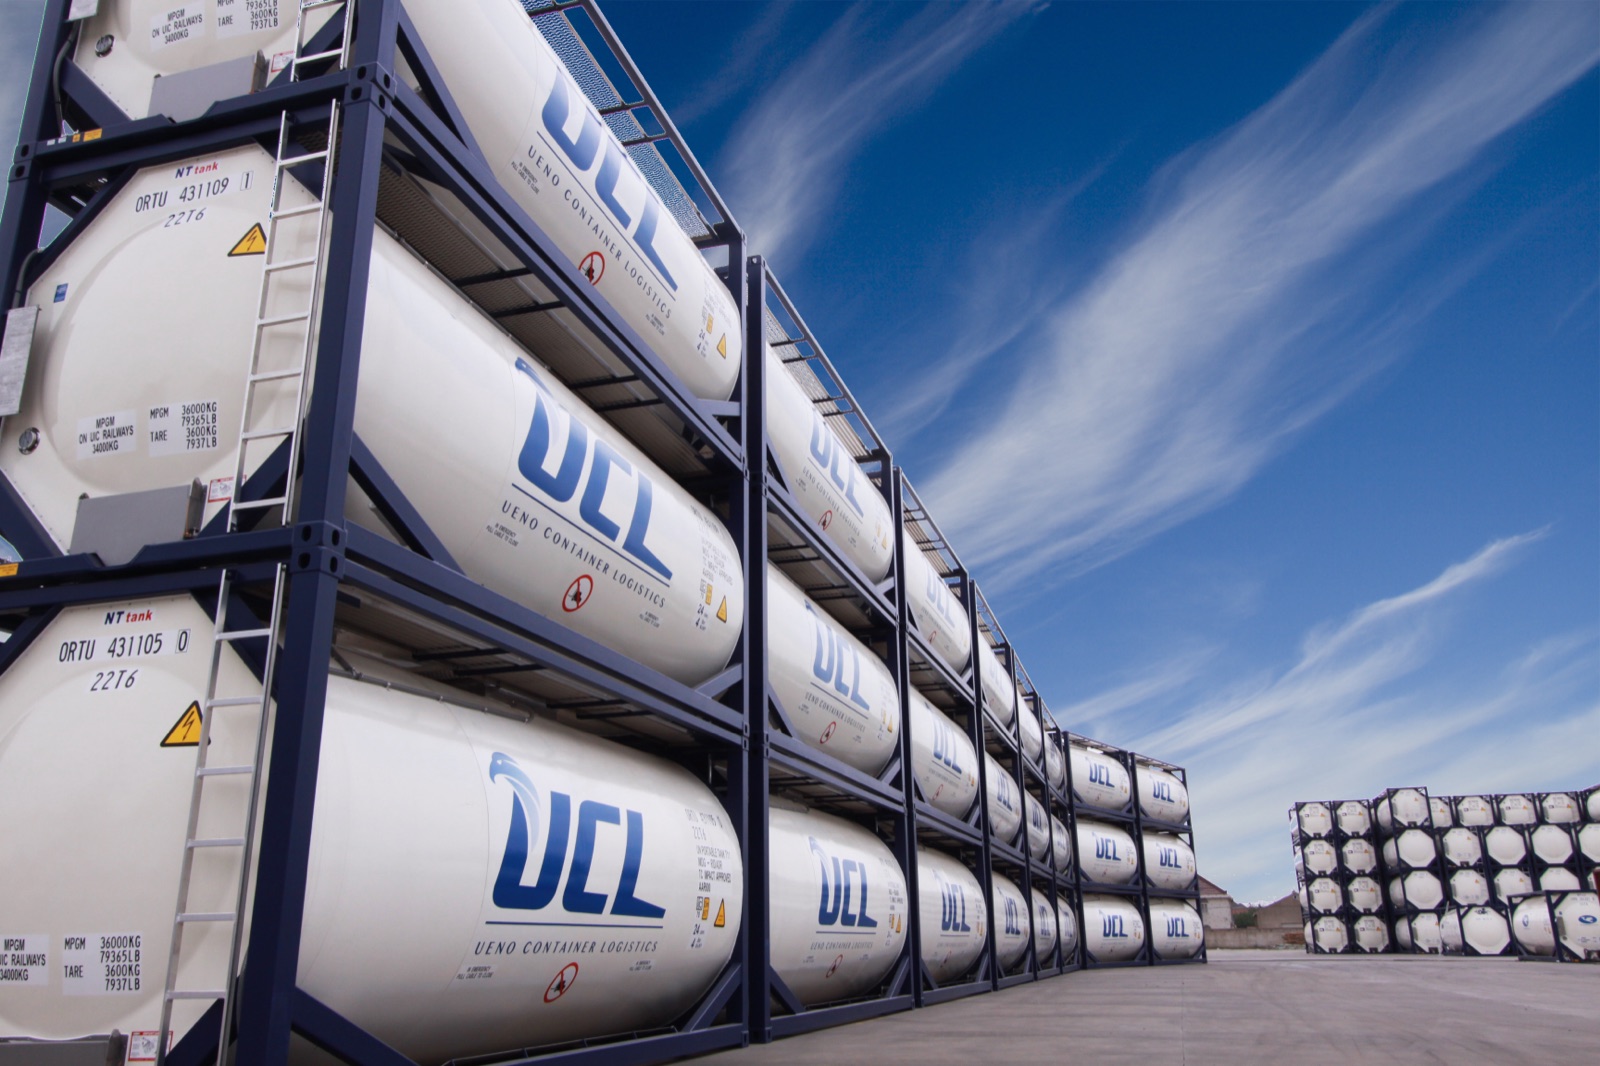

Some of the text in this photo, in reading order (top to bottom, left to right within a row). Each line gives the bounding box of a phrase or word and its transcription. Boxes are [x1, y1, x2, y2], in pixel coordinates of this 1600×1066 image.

[167, 8, 185, 22] MPGM
[218, 14, 234, 27] TARE
[250, 8, 278, 20] 3600KG
[152, 14, 202, 38] ON UIC RAILWAYS
[250, 18, 278, 30] 7937LB
[165, 29, 188, 44] 34000KG
[194, 162, 218, 174] tank
[135, 191, 168, 212] ORTU
[179, 177, 230, 202] 431109
[164, 208, 206, 228] 22T6
[528, 144, 560, 186] UENO
[564, 189, 621, 261] CONTAINER
[624, 262, 672, 319] LOGISTICS
[150, 407, 169, 419] MPGM
[182, 402, 217, 416] 36000KG
[96, 416, 115, 429] MPGM
[181, 414, 217, 427] 79365LB
[79, 426, 134, 444] ON UIC RAILWAYS
[150, 430, 168, 442] TARE
[186, 425, 217, 438] 3600KG
[92, 441, 118, 454] 34000KG
[186, 437, 217, 450] 7937LB
[518, 389, 673, 580] UCL
[502, 500, 538, 530] UENO
[544, 527, 610, 575] CONTAINER
[613, 569, 666, 608] LOGISTICS
[126, 610, 152, 622] tank
[59, 630, 189, 662] ORTU 431105 0
[813, 619, 870, 711] UCL
[90, 669, 138, 692] 22T6
[1089, 763, 1115, 788] UCL
[1153, 779, 1175, 803] UCL
[492, 790, 666, 919] UCL
[1095, 837, 1121, 862] UCL
[1159, 847, 1182, 869] UCL
[818, 856, 878, 928] UCL
[941, 882, 970, 932] UCL
[1103, 915, 1128, 938] UCL
[1167, 917, 1189, 938] UCL
[4, 939, 25, 951] MPGM
[64, 937, 86, 950] MPGM
[100, 936, 141, 949] 36000KG
[474, 941, 658, 955] UENO CONTAINER LOGISTICS
[11, 954, 46, 966] RAILWAYS
[100, 950, 140, 963] 79365LB
[64, 965, 84, 978] TARE
[105, 964, 140, 977] 3600KG
[105, 978, 140, 991] 7937LB
